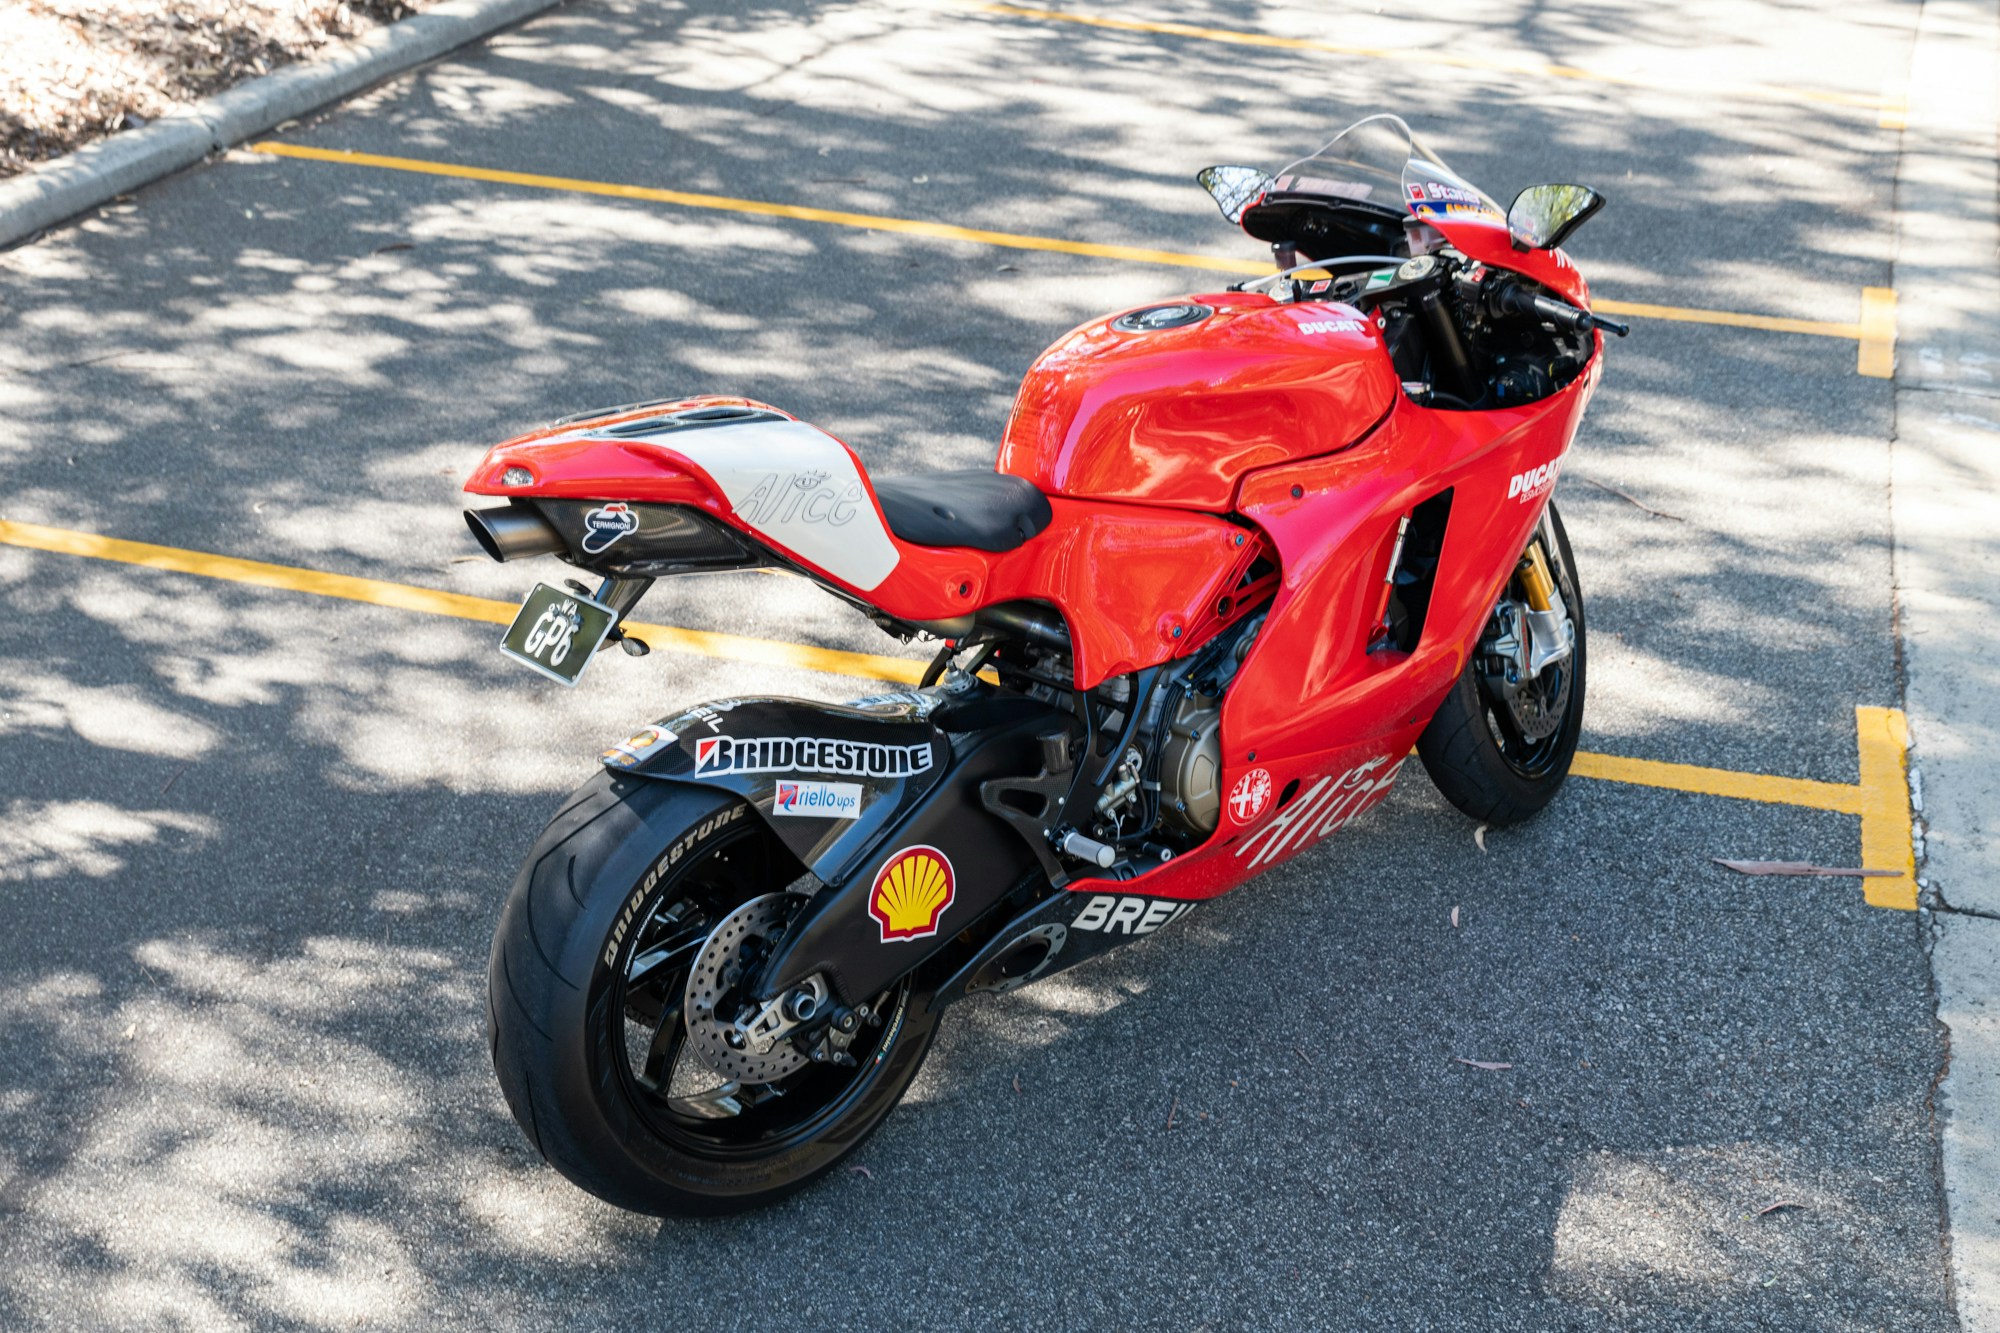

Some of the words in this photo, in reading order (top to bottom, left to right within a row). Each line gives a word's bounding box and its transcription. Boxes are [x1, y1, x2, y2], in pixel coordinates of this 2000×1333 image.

[1298, 319, 1366, 336] DUCATI
[731, 470, 863, 527] Alice
[592, 520, 632, 531] TERMIGNONI
[524, 611, 576, 667] GP6
[695, 735, 933, 779] BRIDGESTONE
[799, 786, 836, 807] riello
[837, 795, 856, 812] ups
[604, 803, 748, 970] BRIDGESTONE
